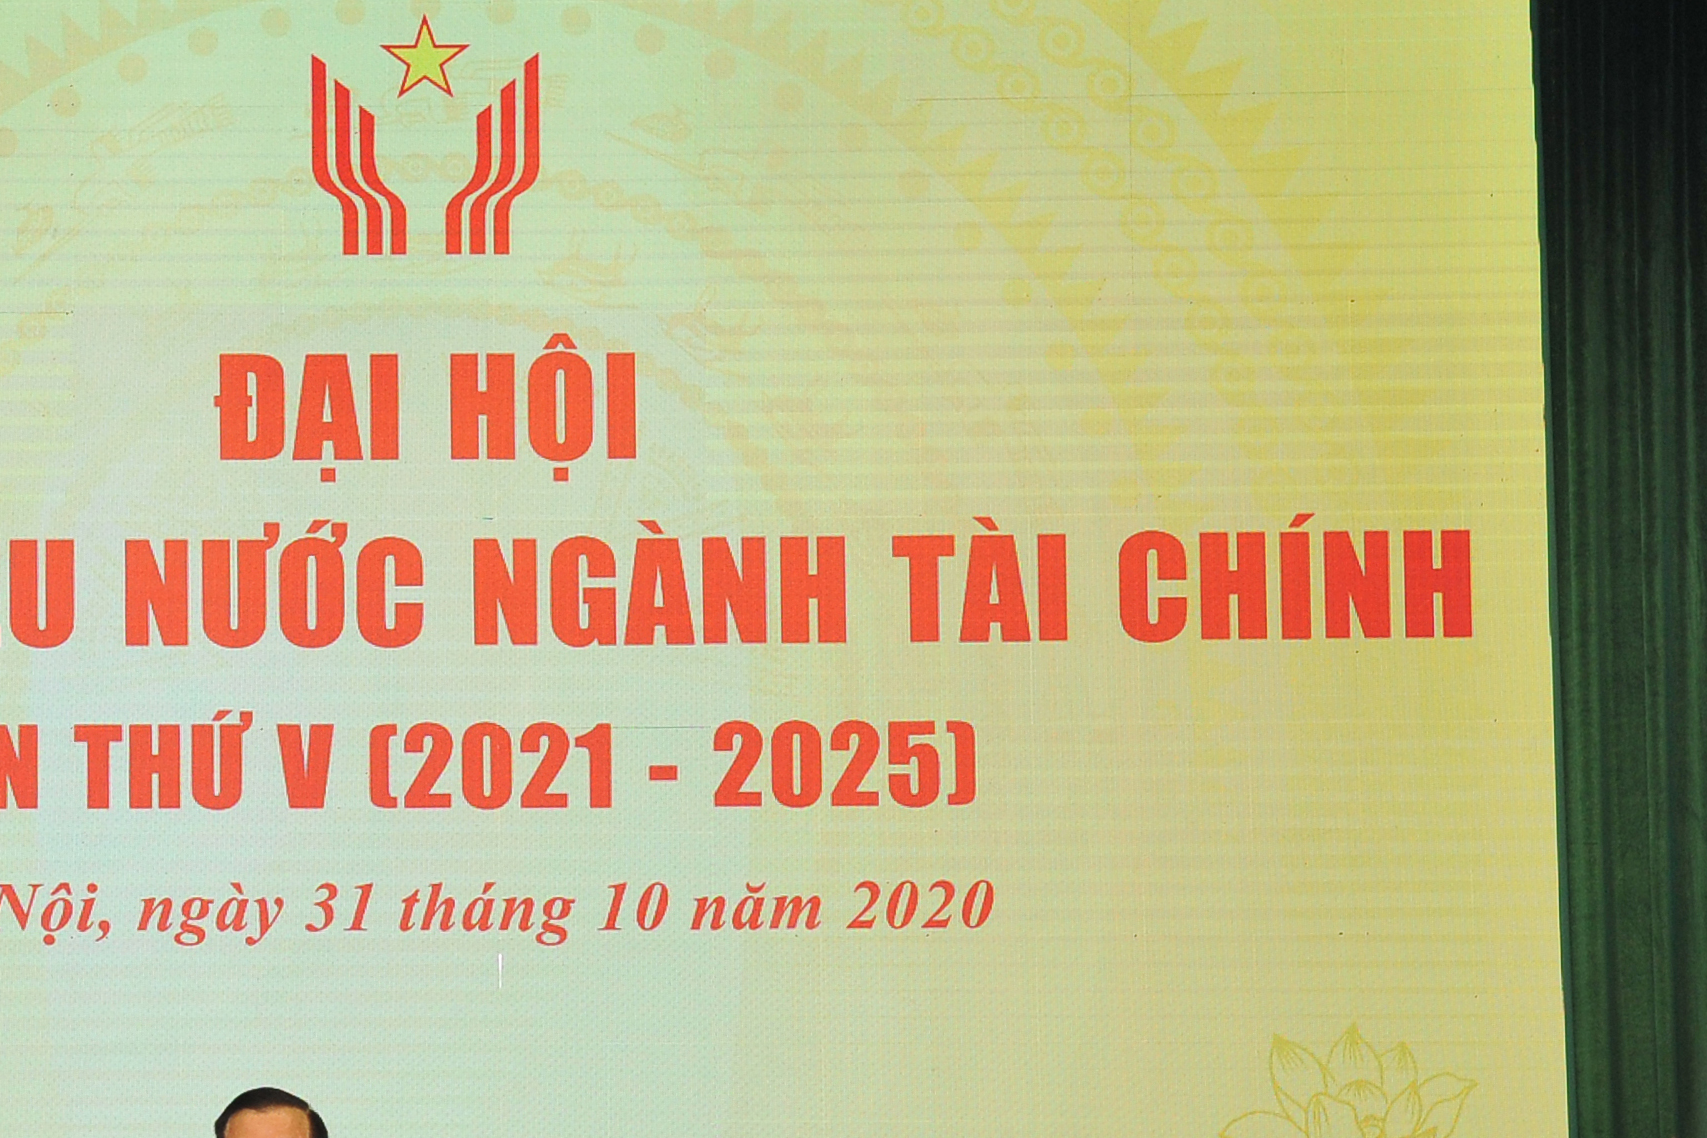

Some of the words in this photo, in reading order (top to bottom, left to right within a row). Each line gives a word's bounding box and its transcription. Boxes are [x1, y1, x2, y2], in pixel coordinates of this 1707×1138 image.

[214, 353, 400, 483] ĐẠI
[450, 332, 637, 482] HỘI
[125, 519, 424, 649] NƯỚC
[474, 519, 848, 648] NGÀNH
[892, 516, 1069, 643] TÀI
[1118, 513, 1474, 644] CHÍNH
[74, 709, 254, 811] THỨ
[276, 723, 335, 810] V
[369, 721, 613, 810] (2021
[649, 764, 679, 781] -
[713, 719, 977, 809] 2025)
[138, 882, 284, 946] ngày
[306, 882, 373, 932] 31
[399, 882, 576, 945] tháng
[599, 882, 669, 931] 10
[691, 883, 822, 931] năm
[847, 879, 995, 930] 2020
